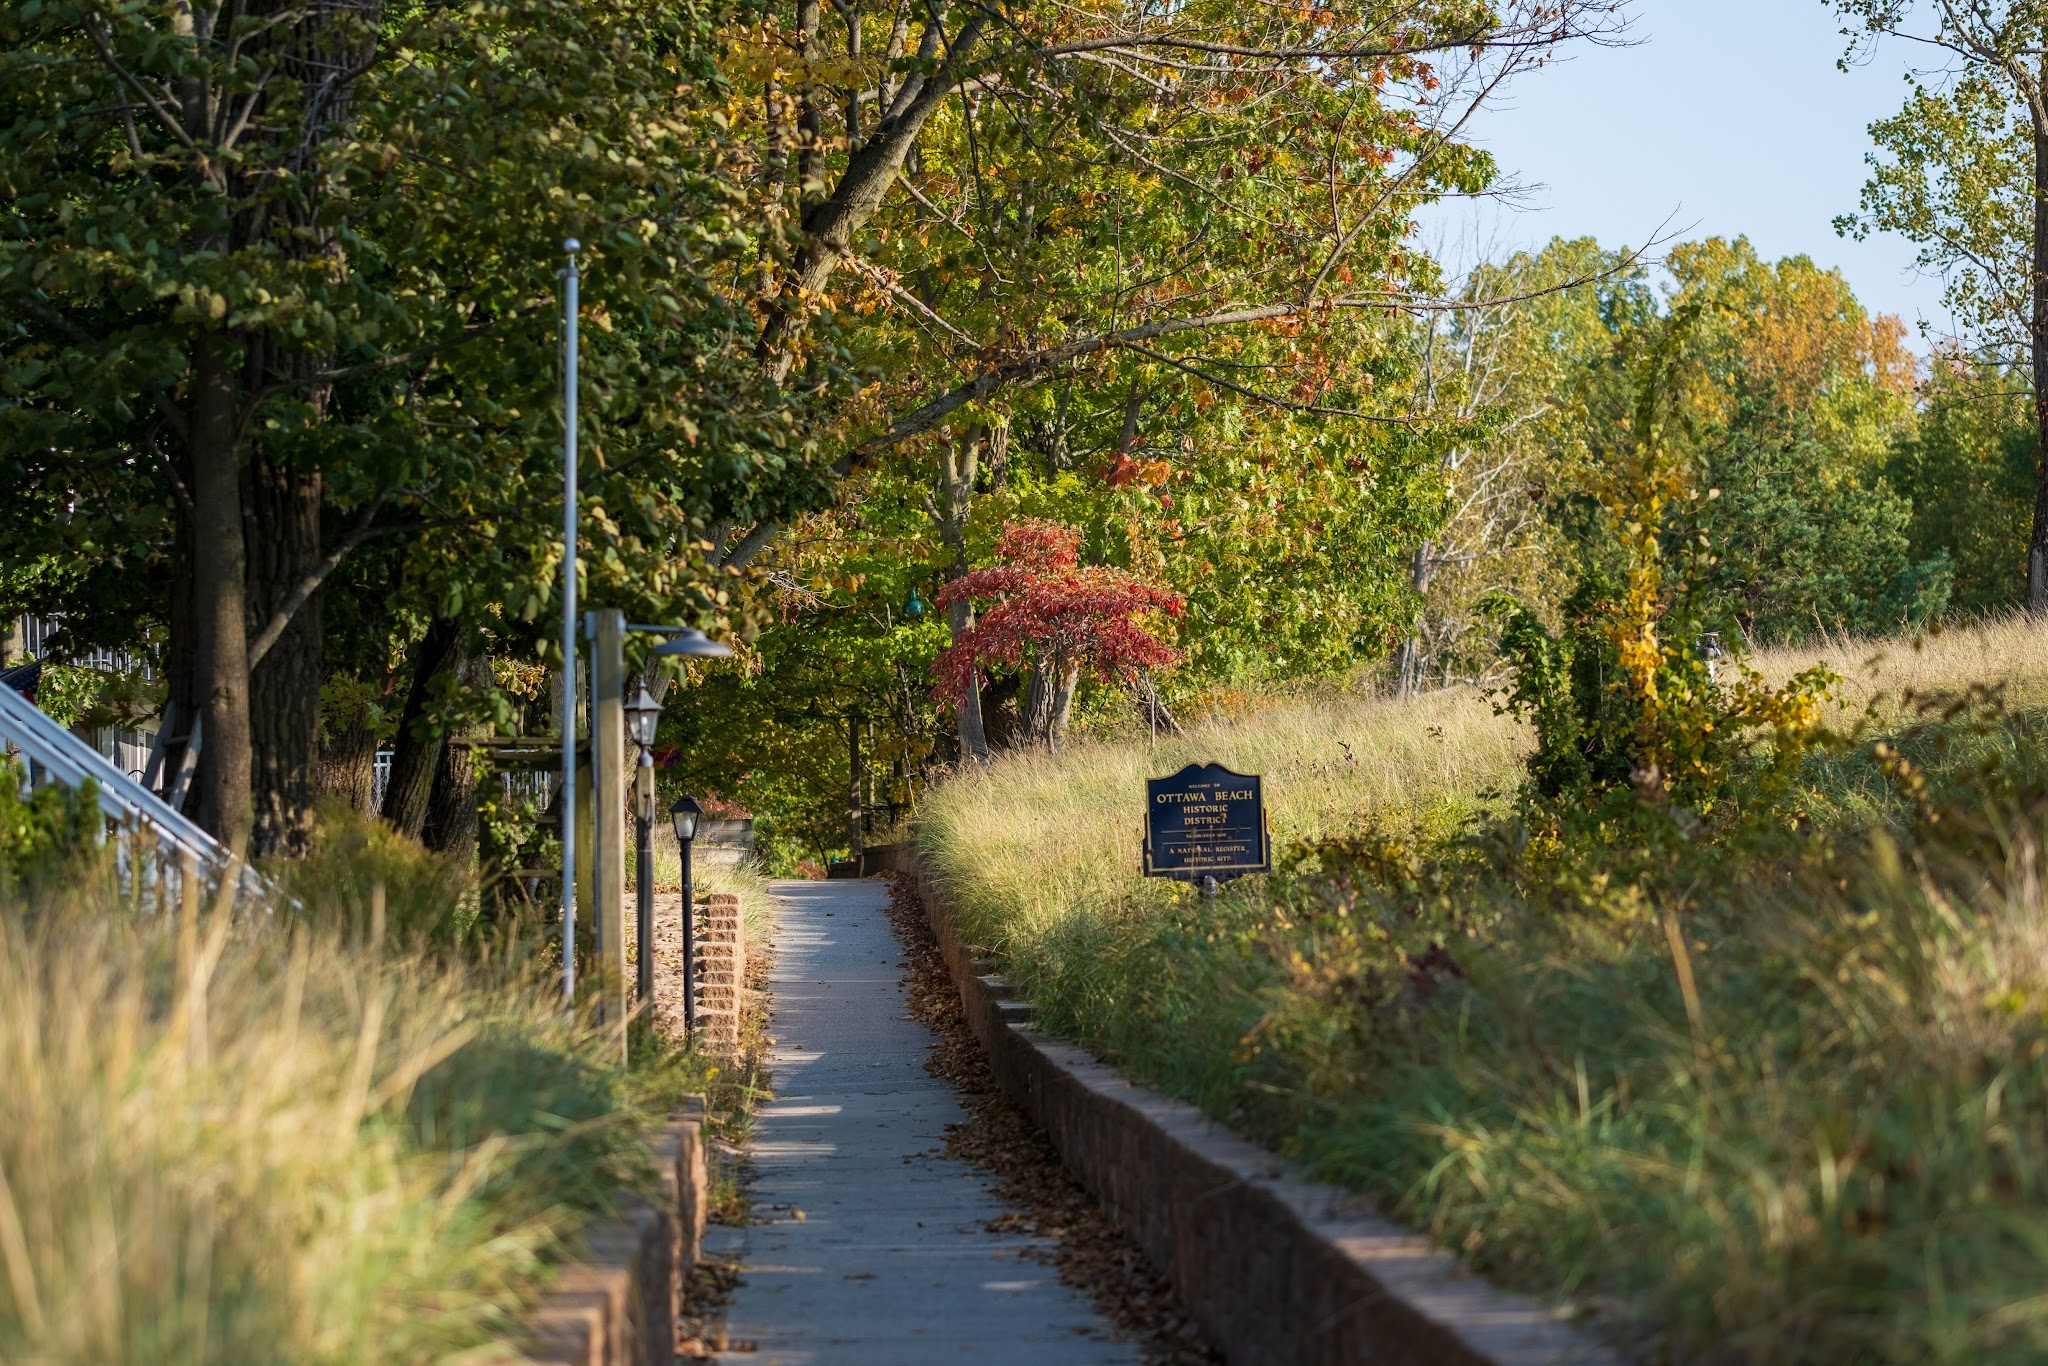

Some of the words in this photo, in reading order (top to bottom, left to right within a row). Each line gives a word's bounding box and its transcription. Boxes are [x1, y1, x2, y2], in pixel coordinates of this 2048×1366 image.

[1156, 792, 1206, 804] OTTAWA
[1215, 790, 1253, 801] BEACH
[1183, 804, 1228, 814] HISTORIC
[1184, 815, 1227, 826] DISTRICT
